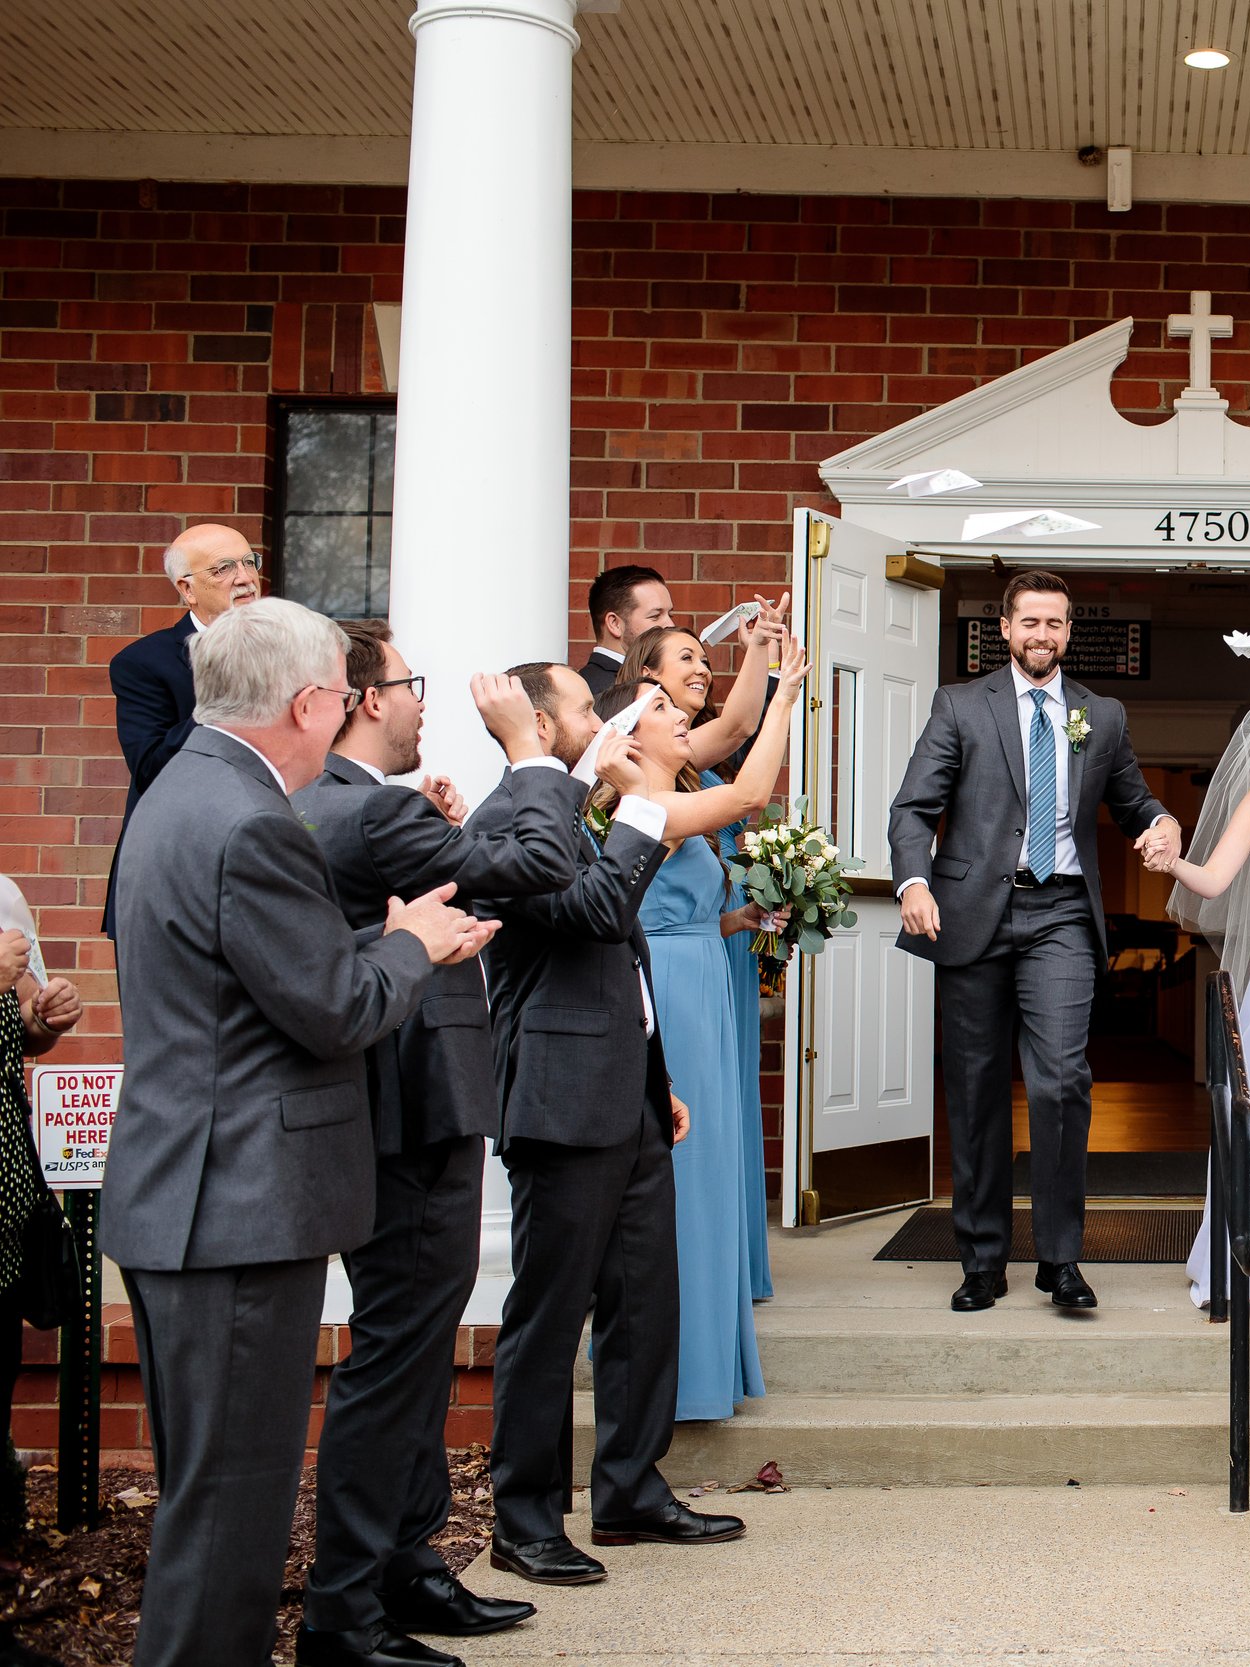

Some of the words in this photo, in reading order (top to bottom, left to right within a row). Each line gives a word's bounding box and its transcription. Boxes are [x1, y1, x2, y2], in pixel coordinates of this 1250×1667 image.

[1154, 511, 1249, 542] 4750
[1072, 625, 1098, 633] Church
[1100, 626, 1127, 634] Offices
[1108, 636, 1127, 645] Wing
[981, 643, 1000, 651] Child
[1071, 645, 1111, 654] Fellowship
[1112, 645, 1127, 653] Hall
[1079, 654, 1116, 662] Restroom
[1079, 663, 1116, 672] Restroom
[57, 1076, 78, 1090] DO
[83, 1075, 116, 1090] NOT
[62, 1094, 111, 1108] LEAVE
[66, 1130, 108, 1144] HERE
[76, 1148, 107, 1159] FedEx
[59, 1161, 90, 1172] USPS
